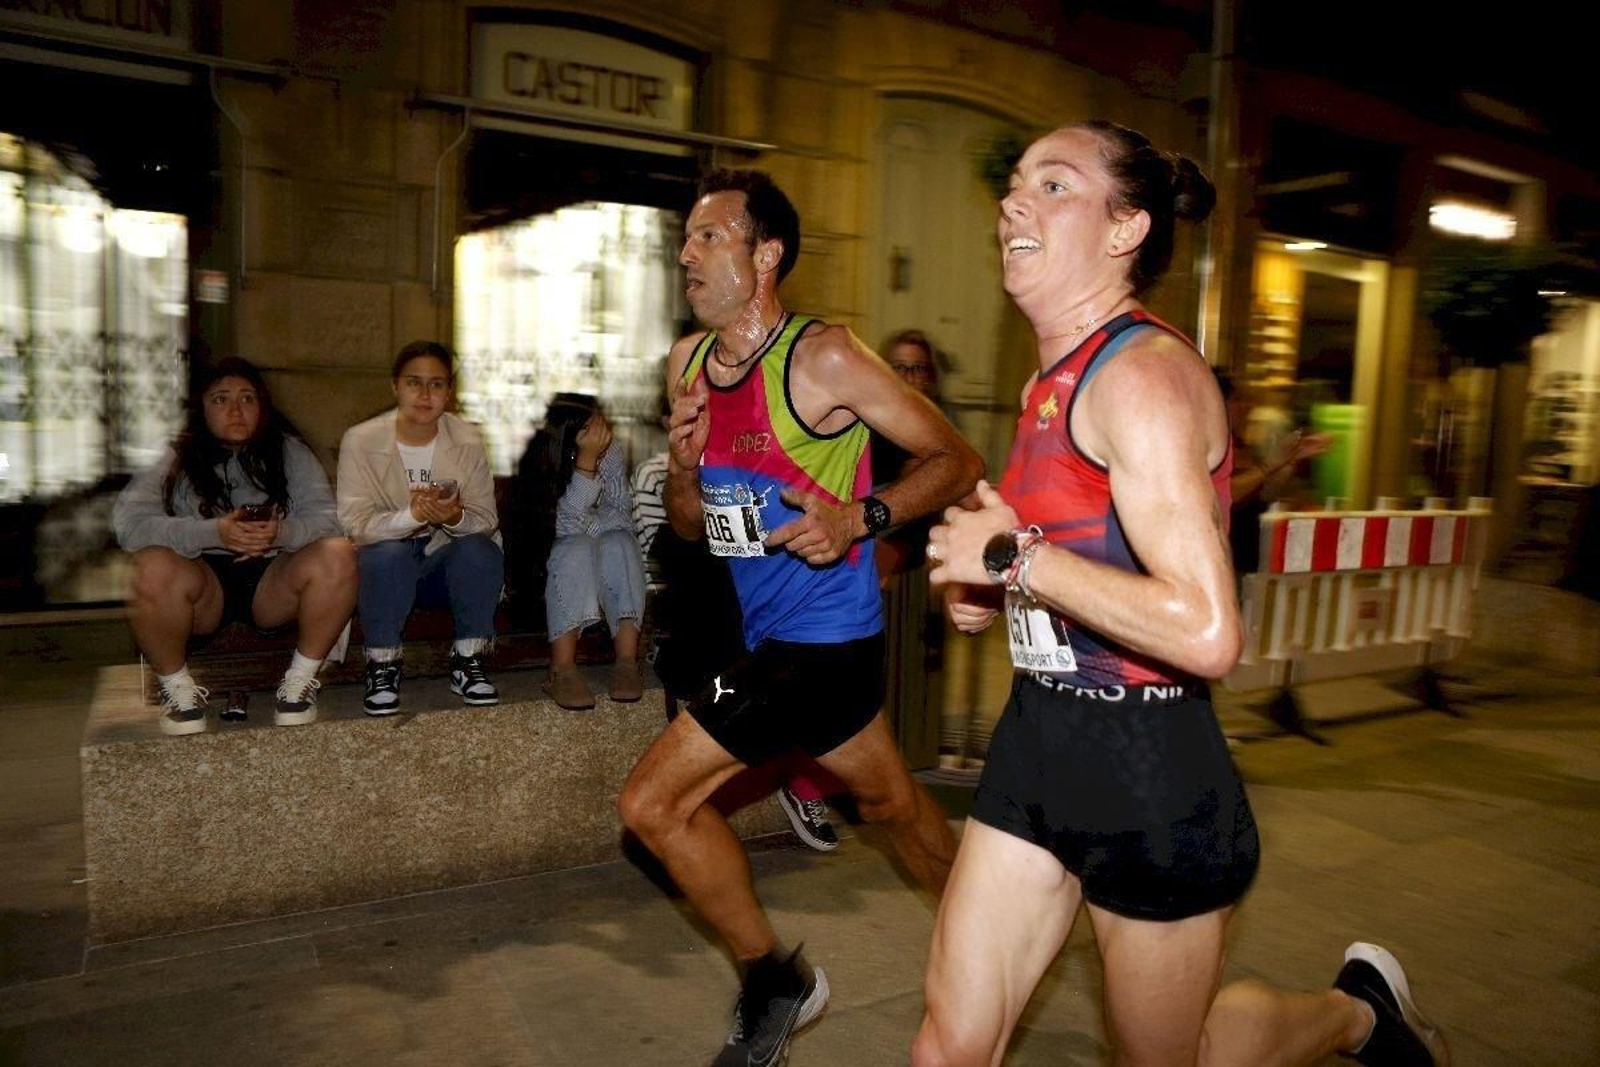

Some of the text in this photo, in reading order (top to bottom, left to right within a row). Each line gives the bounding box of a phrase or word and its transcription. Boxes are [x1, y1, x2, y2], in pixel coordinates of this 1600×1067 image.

[504, 51, 665, 118] CASTOR
[732, 432, 771, 453] LOPEZ
[704, 511, 736, 543] 06
